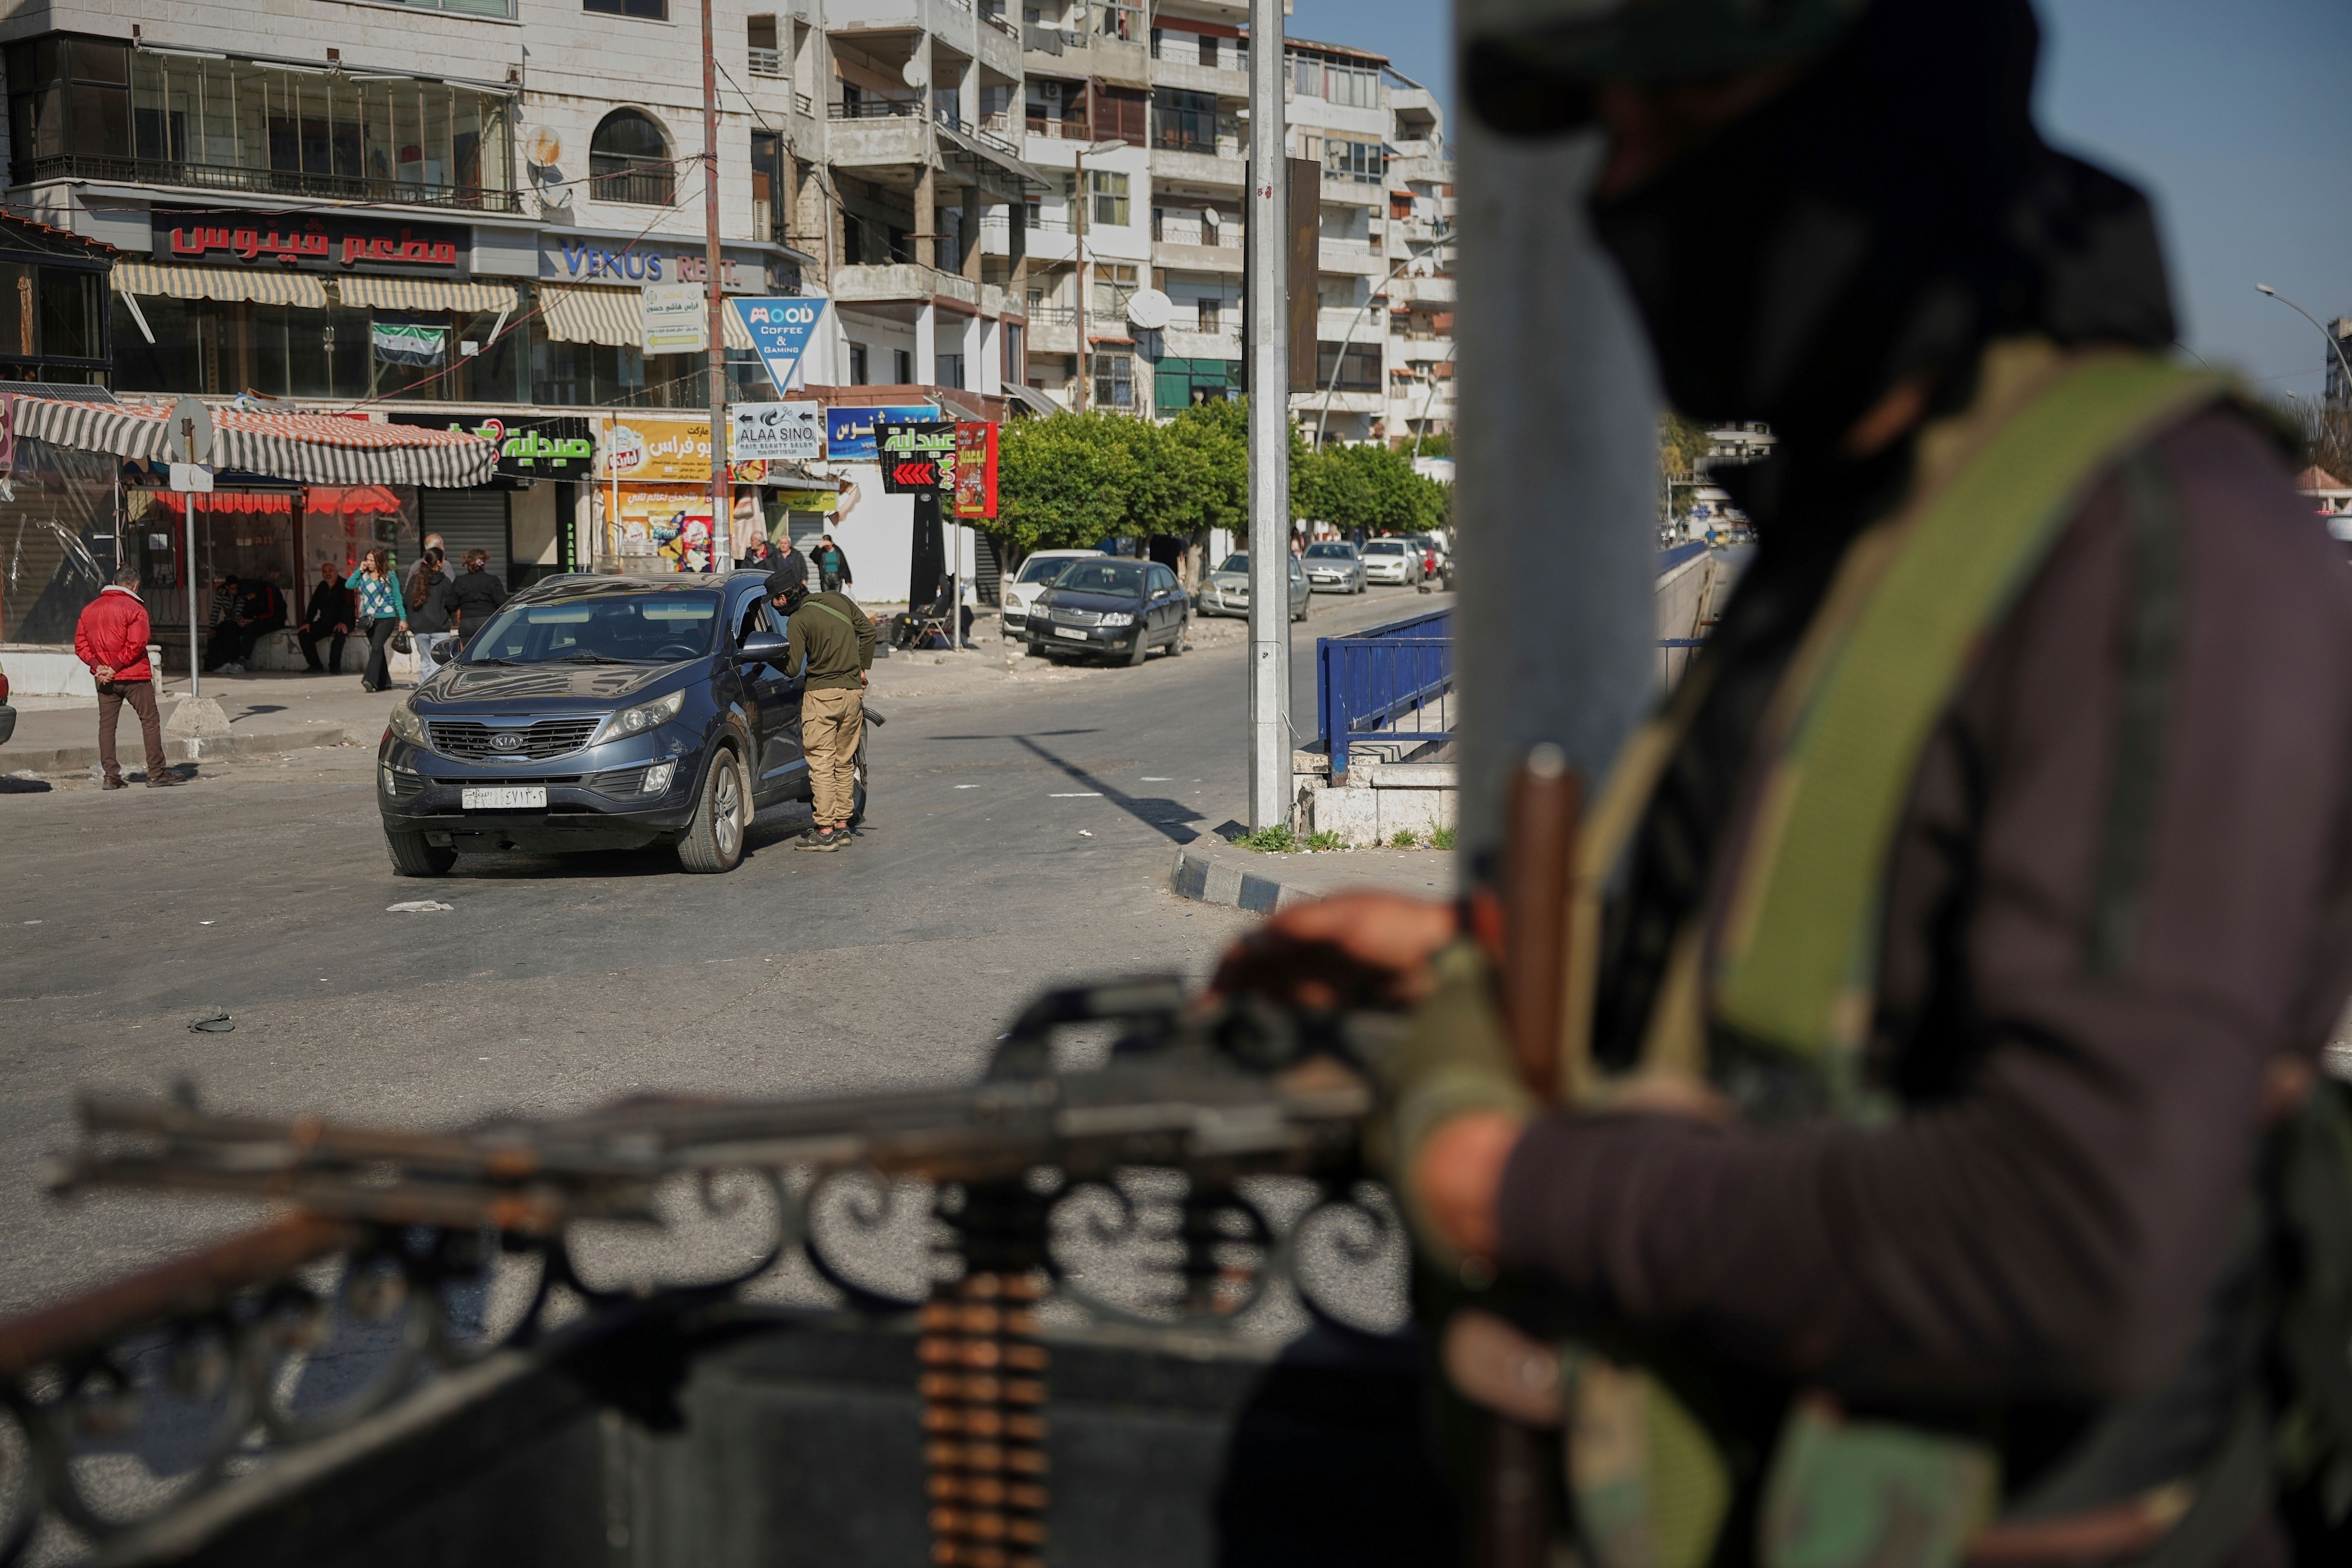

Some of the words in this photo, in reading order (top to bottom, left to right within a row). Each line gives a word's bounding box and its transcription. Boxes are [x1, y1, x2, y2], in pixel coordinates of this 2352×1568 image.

[340, 228, 456, 265] مطعم
[560, 239, 662, 281] VENUS
[677, 255, 741, 287] RET.
[750, 307, 814, 324] MOOD
[776, 336, 787, 346] &
[688, 426, 709, 437] ماركت
[740, 428, 777, 442] ALAA
[780, 427, 814, 441] SINO
[501, 428, 592, 468] صيدلية
[649, 436, 695, 459] فراس
[495, 737, 517, 746] KIA
